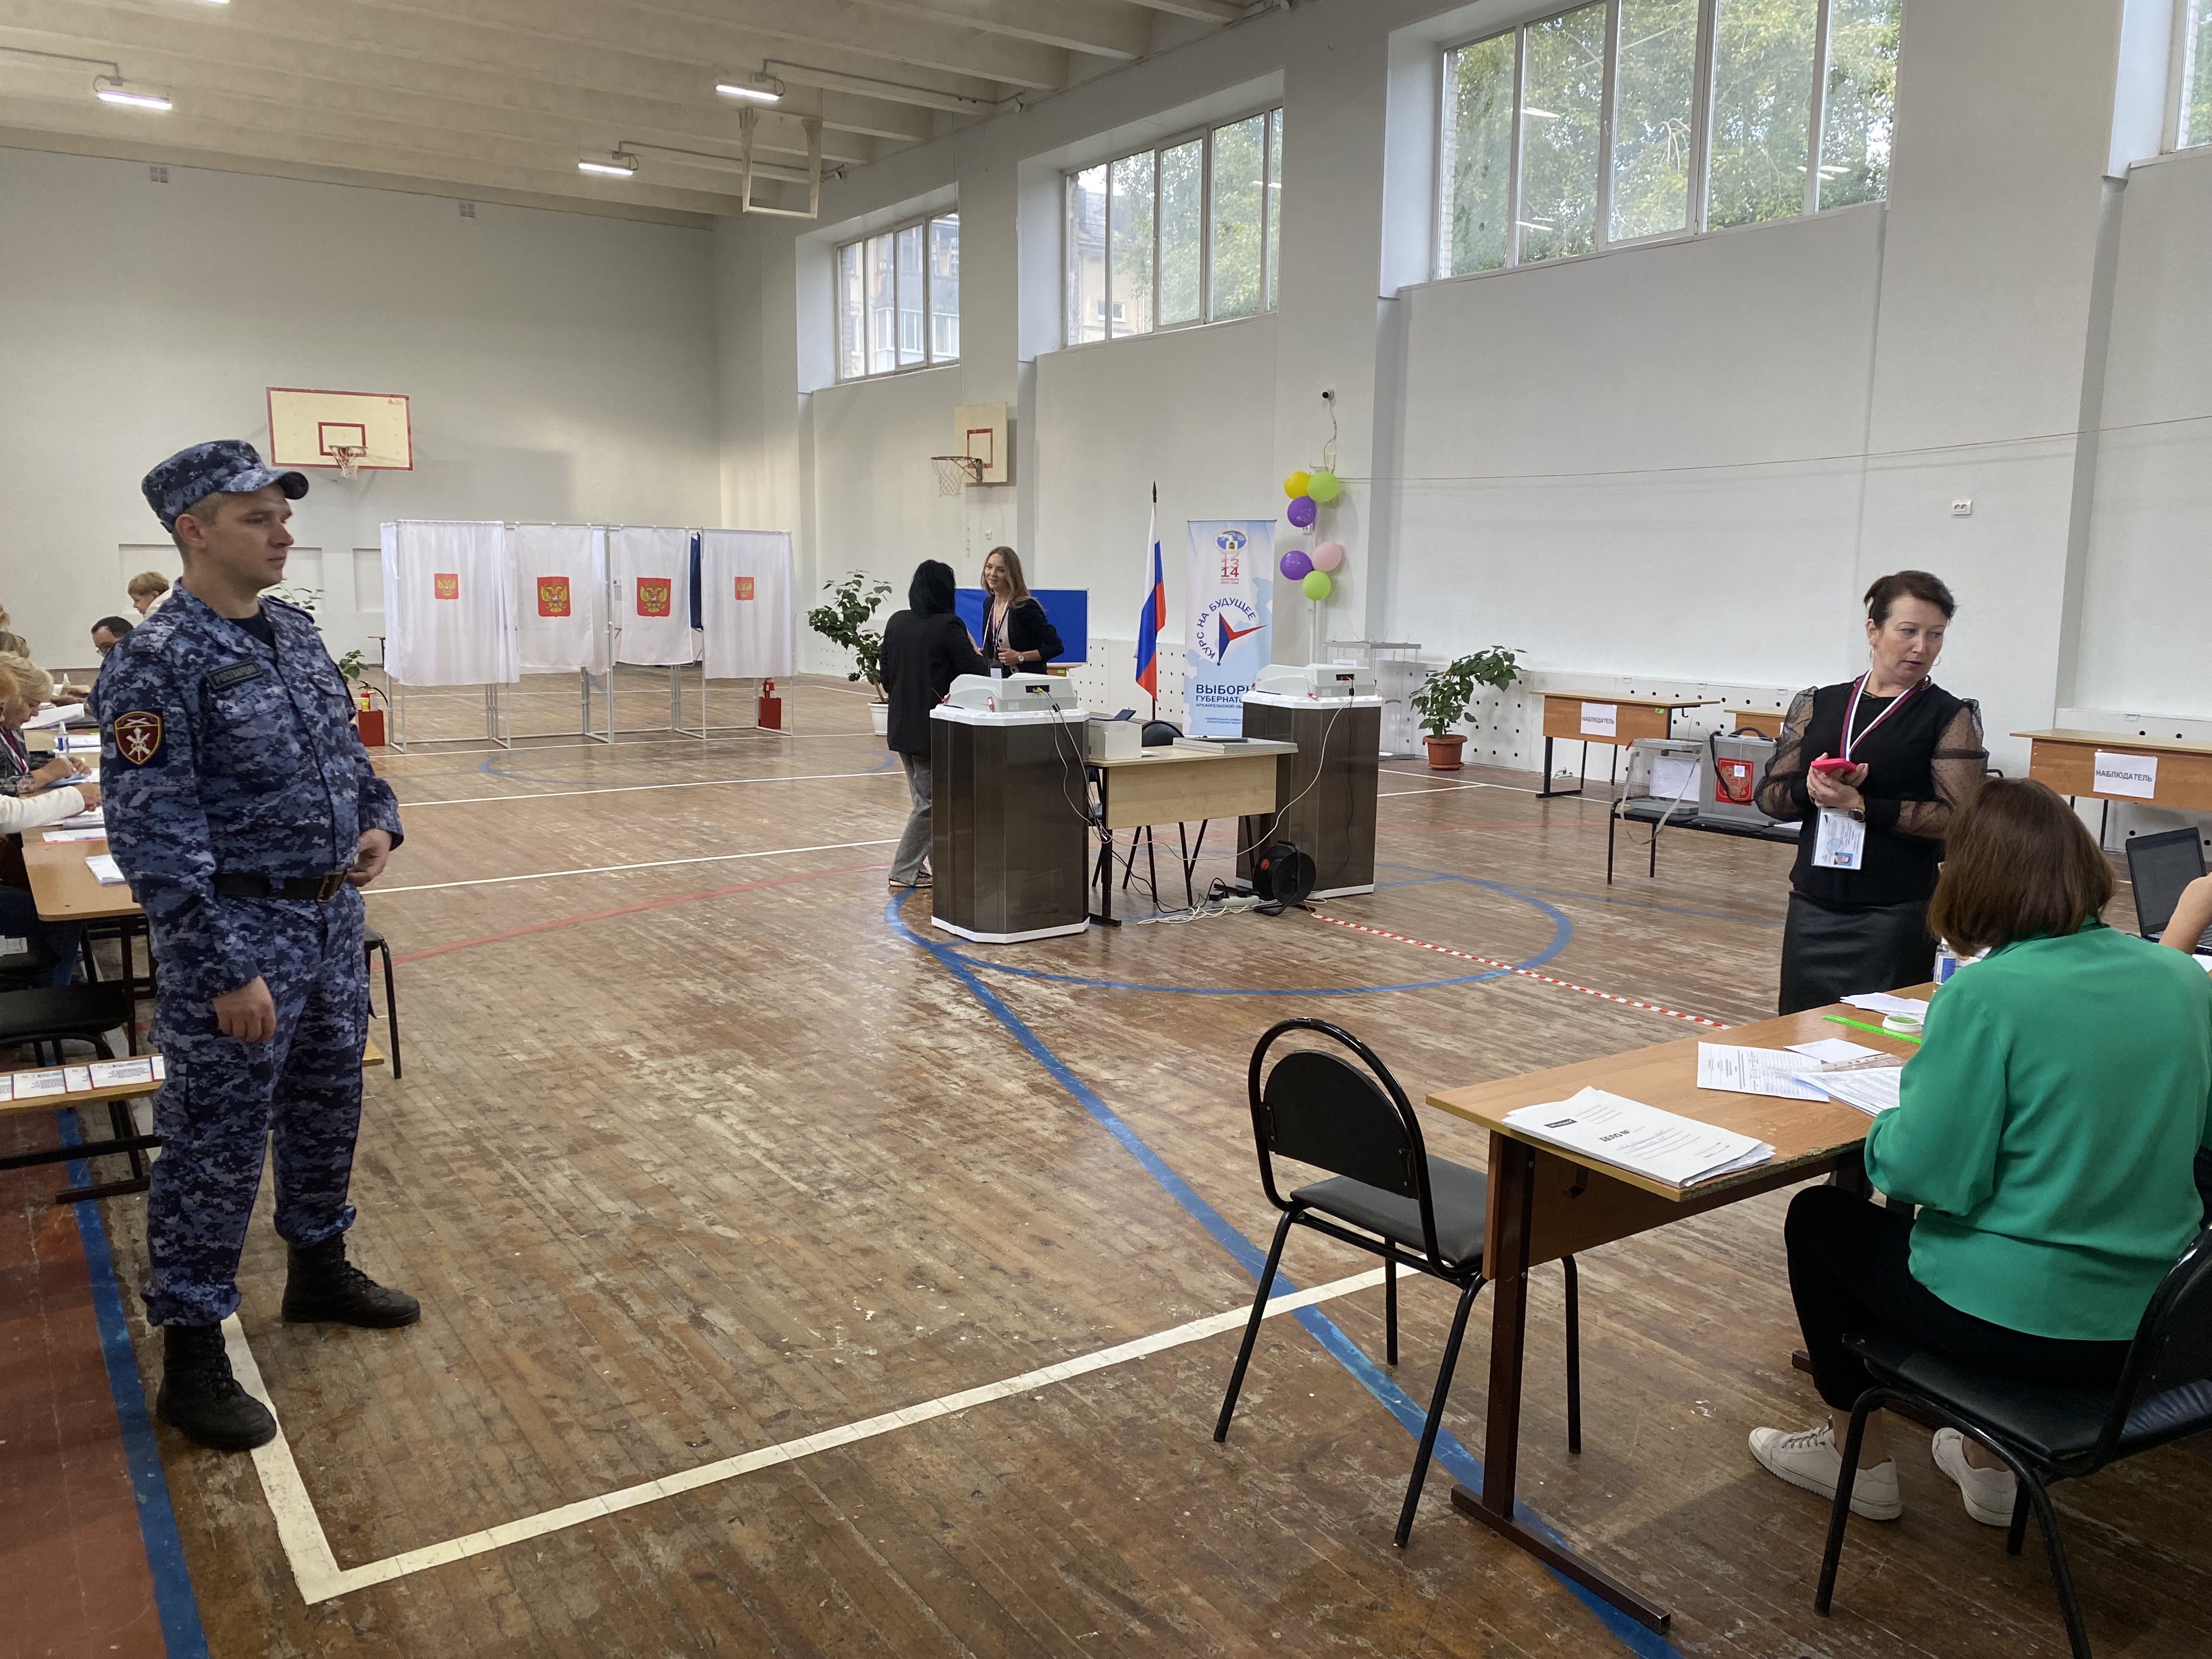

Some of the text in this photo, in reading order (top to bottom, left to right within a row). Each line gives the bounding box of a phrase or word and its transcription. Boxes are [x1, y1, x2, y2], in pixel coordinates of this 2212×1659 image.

[1221, 558, 1239, 568] 13
[1221, 567, 1239, 577] 14
[1197, 597, 1256, 659] КУРС НА БУДУЩЕЕ
[1582, 716, 1615, 724] НАБЛЮДАТЕЛЬ
[2096, 769, 2153, 782] НАБЛЮДАТЕЛЬ
[1599, 1133, 1623, 1142] ДЕЛО
